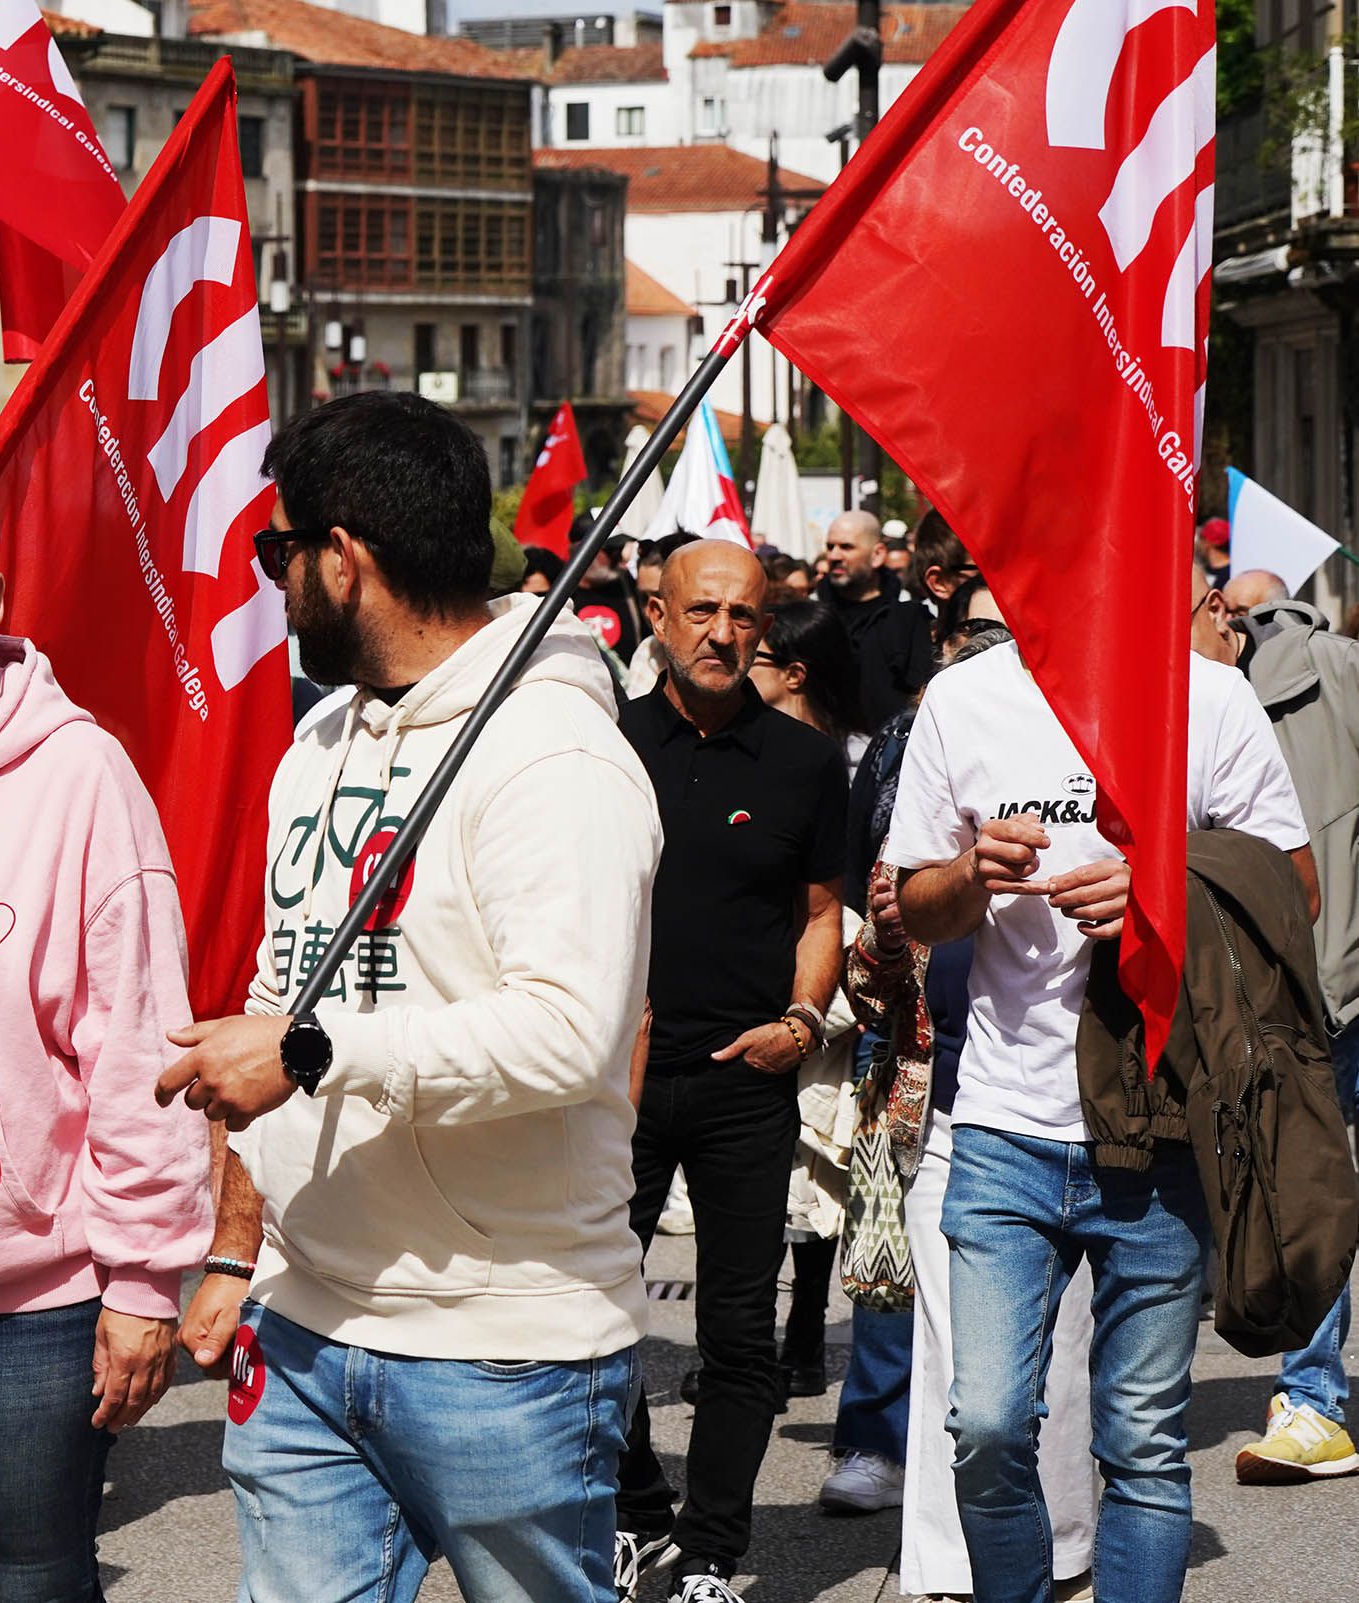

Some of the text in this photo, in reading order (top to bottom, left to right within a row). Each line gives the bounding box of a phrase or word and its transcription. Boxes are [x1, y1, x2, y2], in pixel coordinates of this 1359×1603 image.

[957, 126, 1096, 298] Confederación
[1092, 292, 1164, 438] Intersindical
[78, 378, 210, 722] Confederación Intersindical Galega
